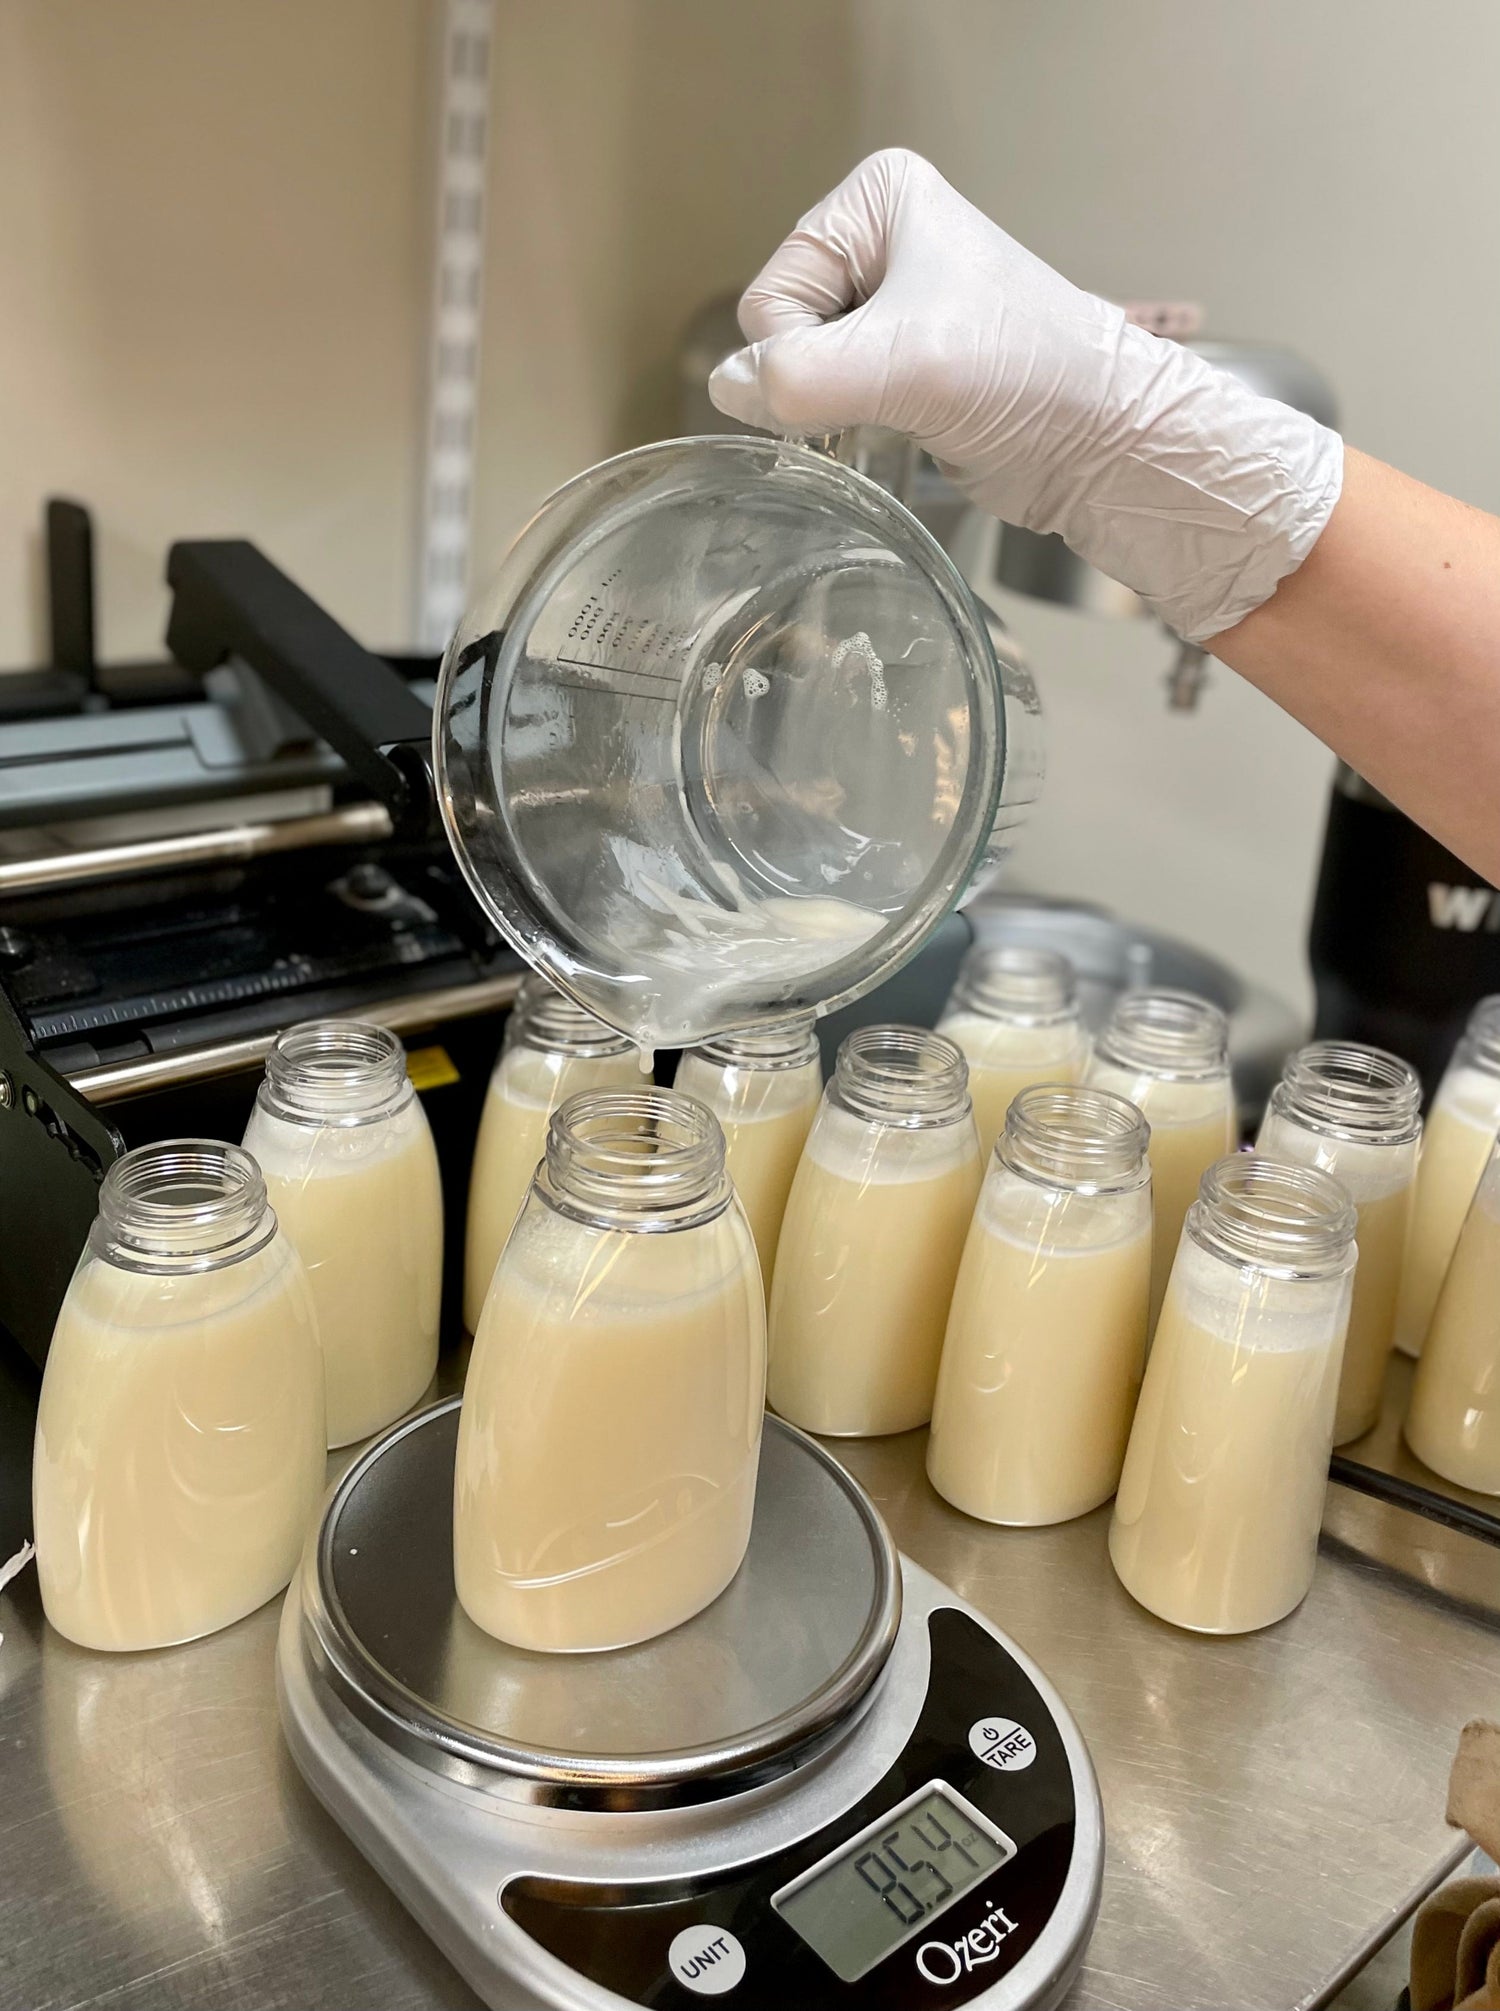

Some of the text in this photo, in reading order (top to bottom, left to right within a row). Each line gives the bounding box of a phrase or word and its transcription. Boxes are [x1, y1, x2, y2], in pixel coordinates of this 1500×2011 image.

[986, 1734, 1032, 1767] TARE
[854, 1811, 979, 1925] 8.54
[680, 1936, 730, 1979] UNIT
[916, 1900, 1019, 1985] Ozeri
